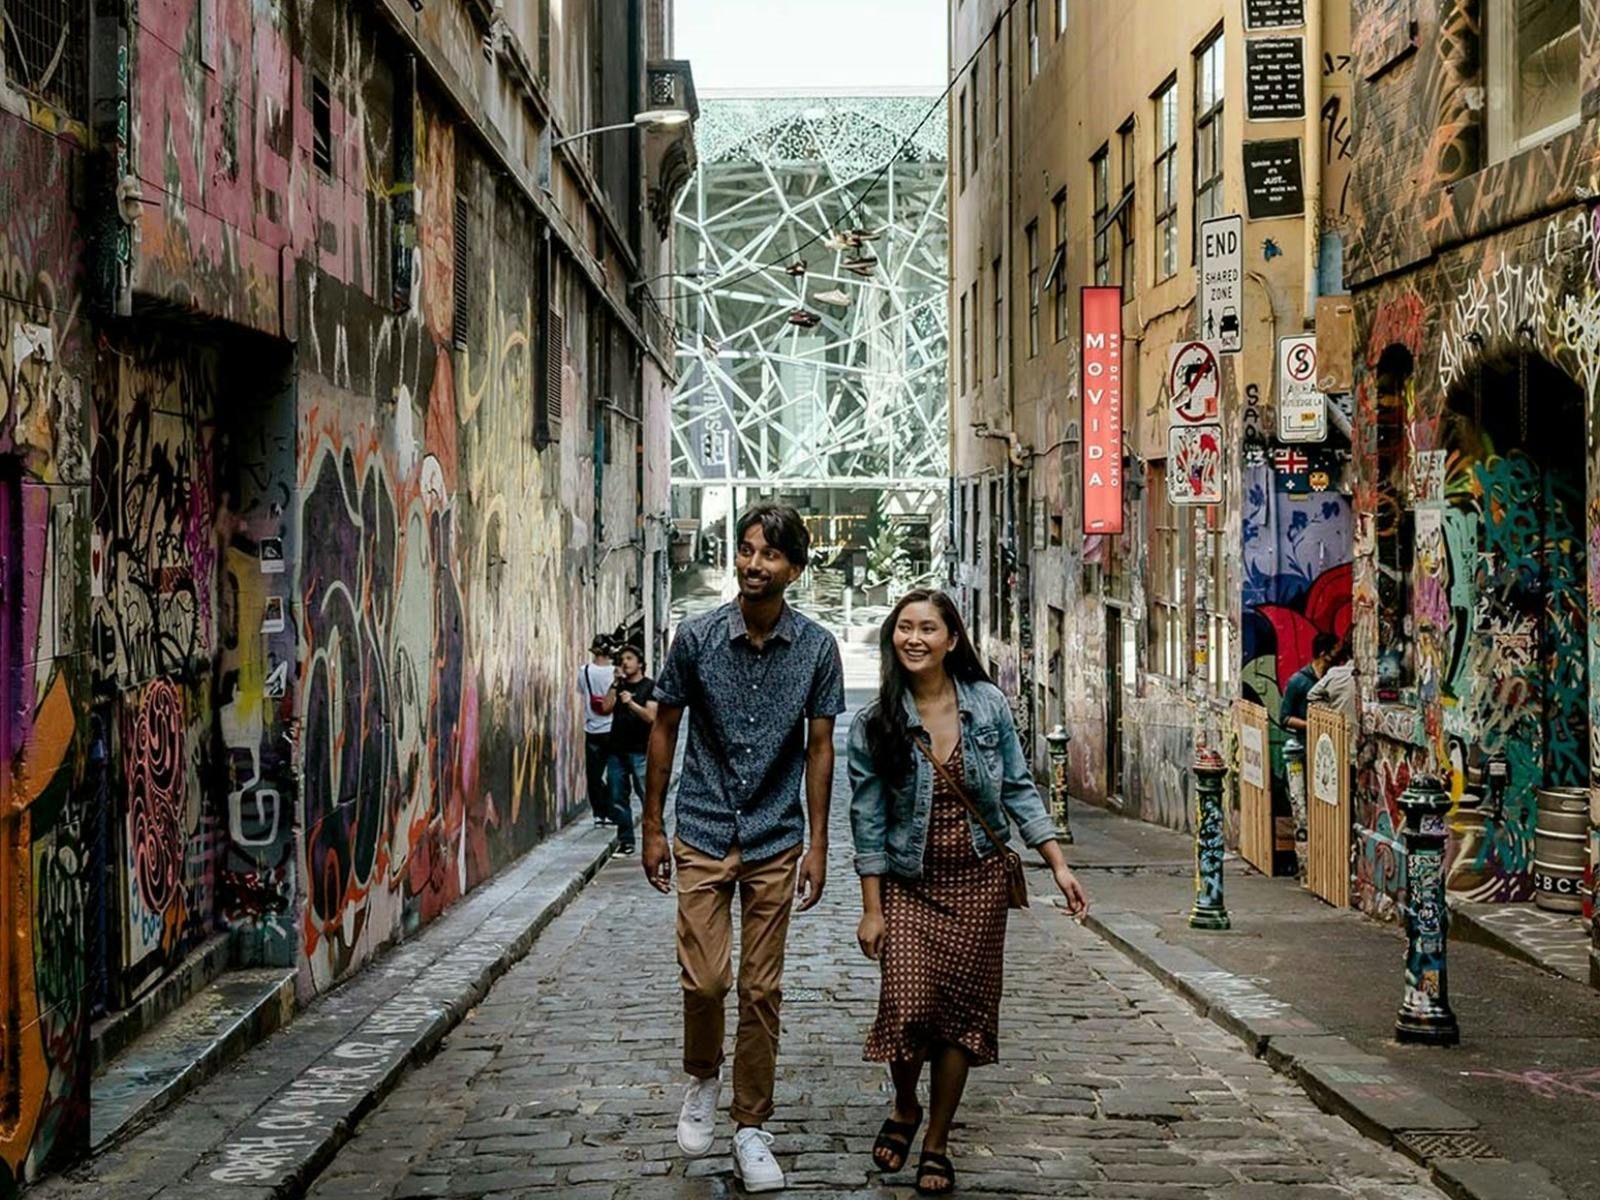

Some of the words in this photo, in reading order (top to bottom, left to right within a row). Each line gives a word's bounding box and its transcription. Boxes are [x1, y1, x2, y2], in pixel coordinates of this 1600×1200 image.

[1206, 230, 1238, 258] END
[1205, 268, 1238, 285] SHARED
[1210, 285, 1232, 301] ZONE
[1086, 332, 1105, 487] MOVIDA
